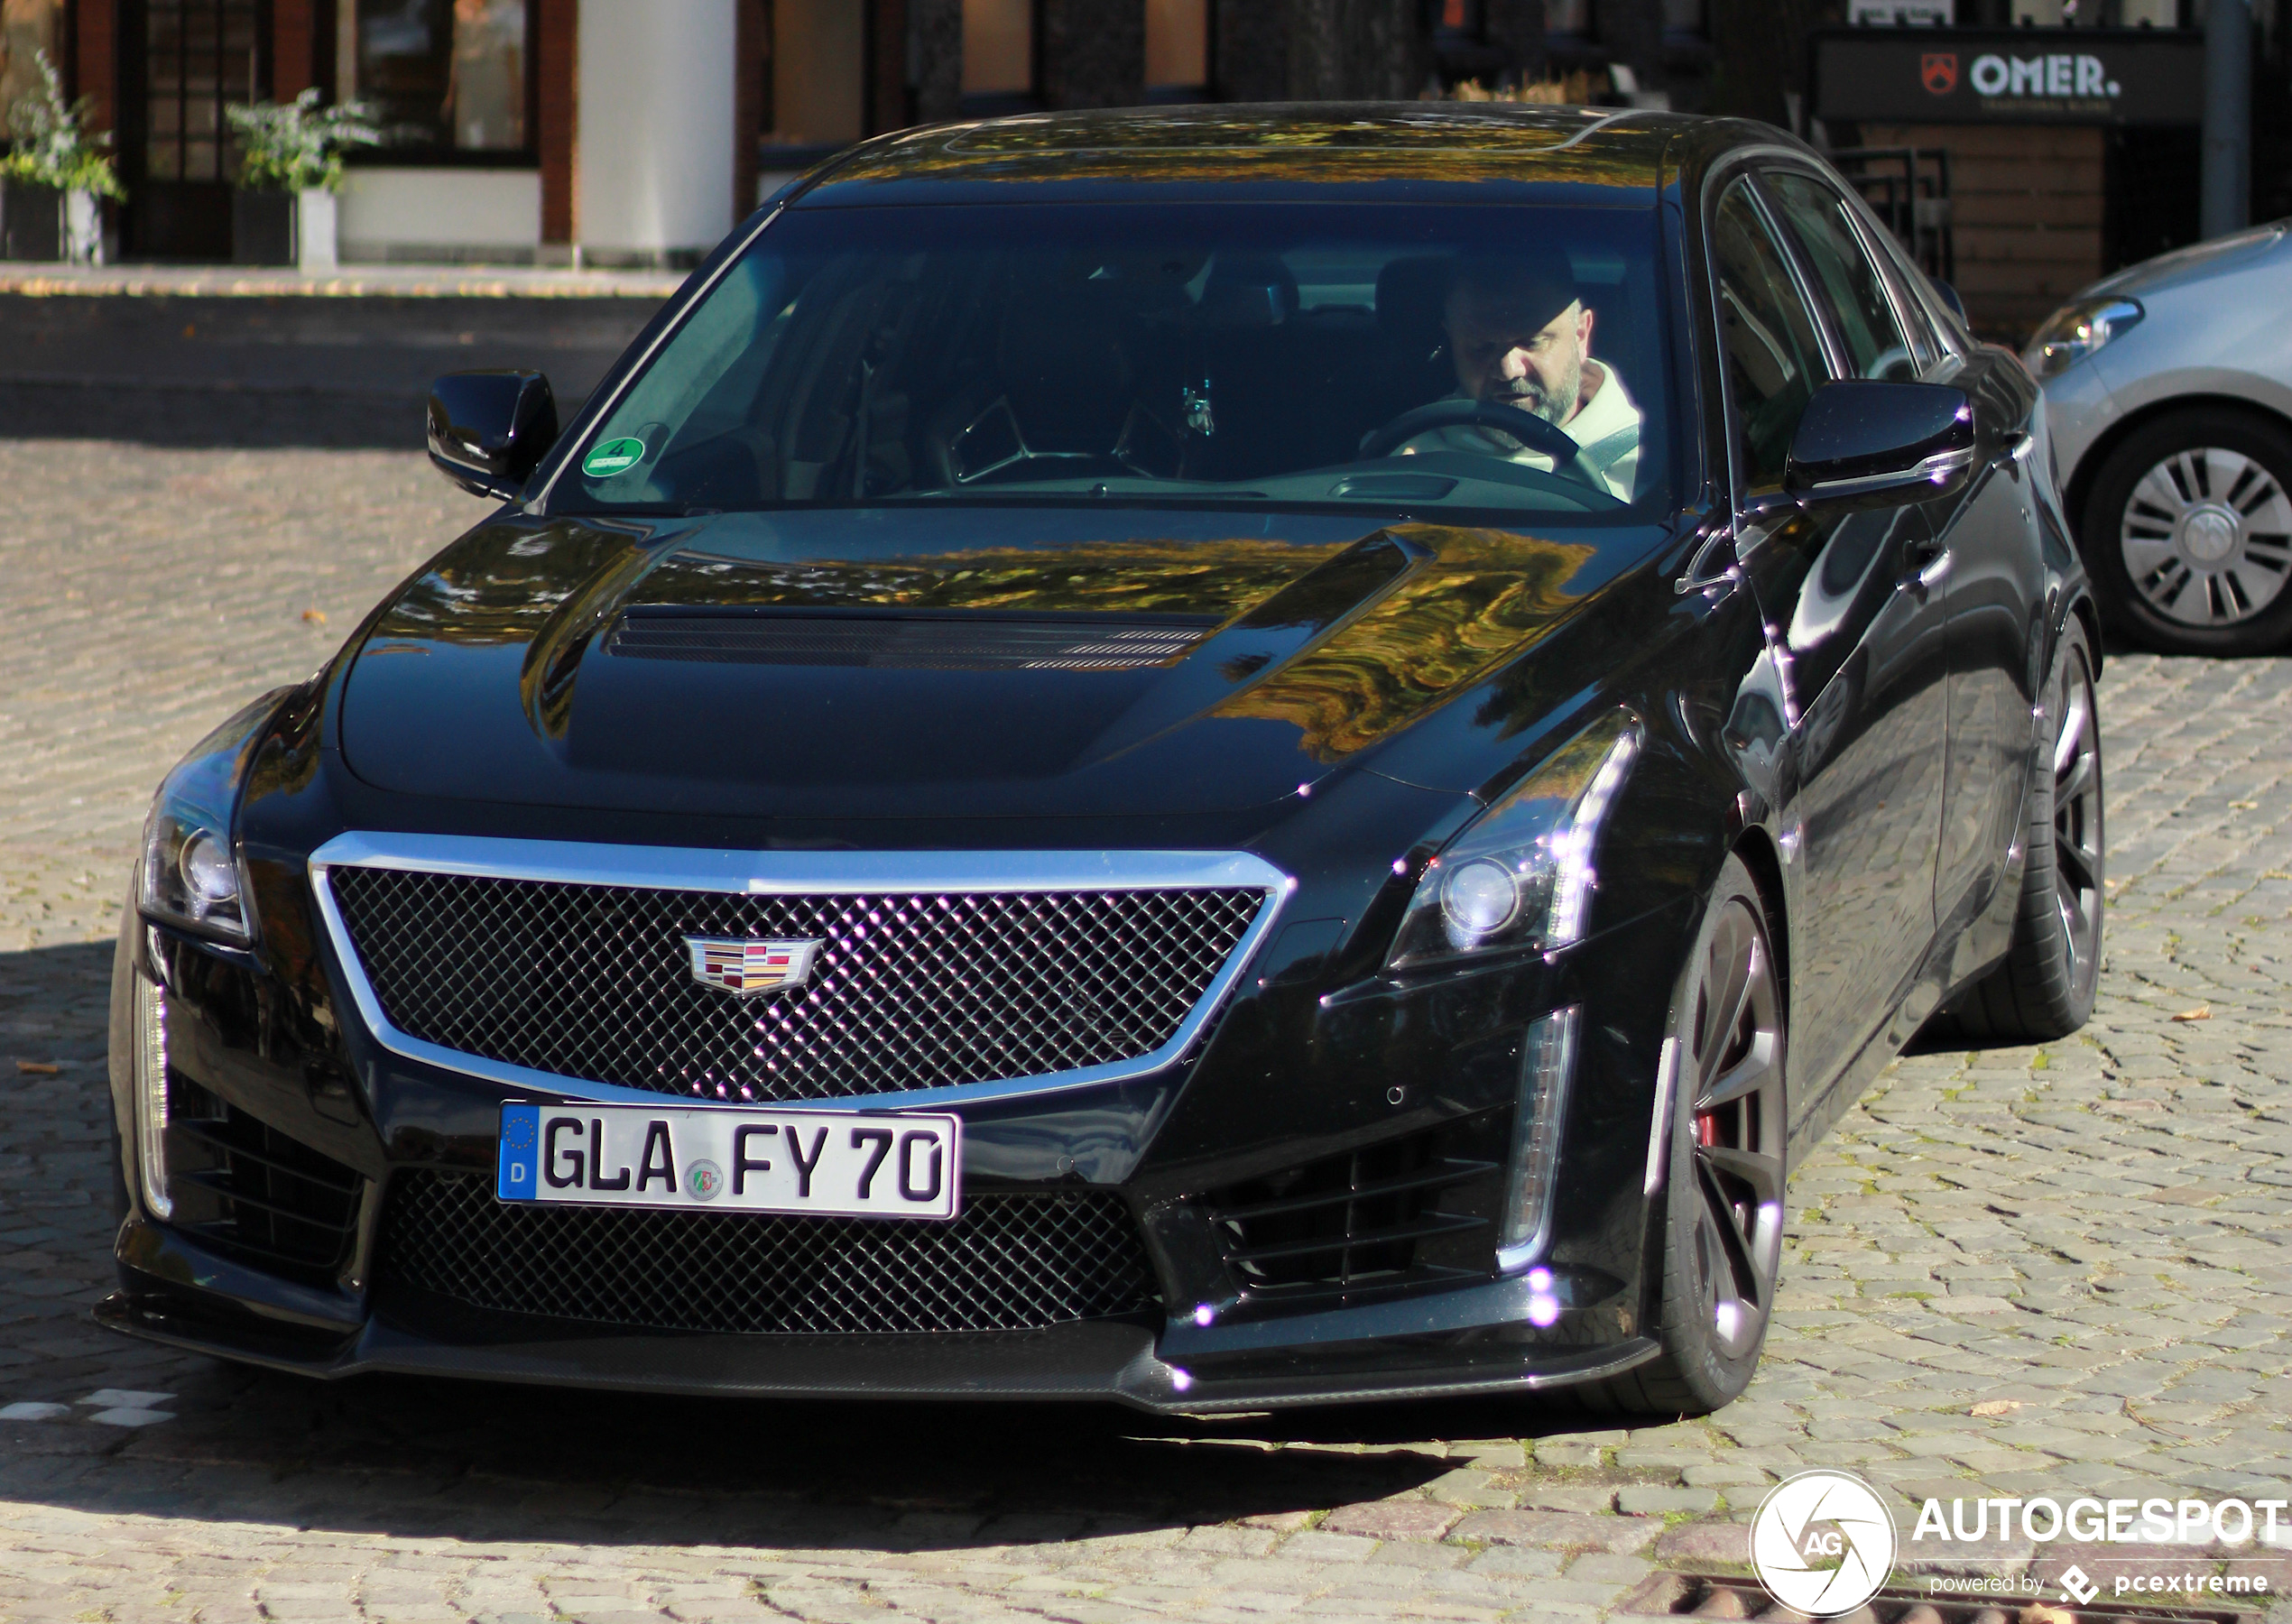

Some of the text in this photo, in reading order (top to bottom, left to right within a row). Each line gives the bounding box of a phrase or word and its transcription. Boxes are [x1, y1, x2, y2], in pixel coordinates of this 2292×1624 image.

[1970, 53, 2121, 97] OMER.
[607, 440, 626, 457] 4
[511, 1163, 525, 1183] D
[543, 1117, 678, 1193] GLA
[732, 1124, 829, 1198] FY
[850, 1129, 942, 1202] 70
